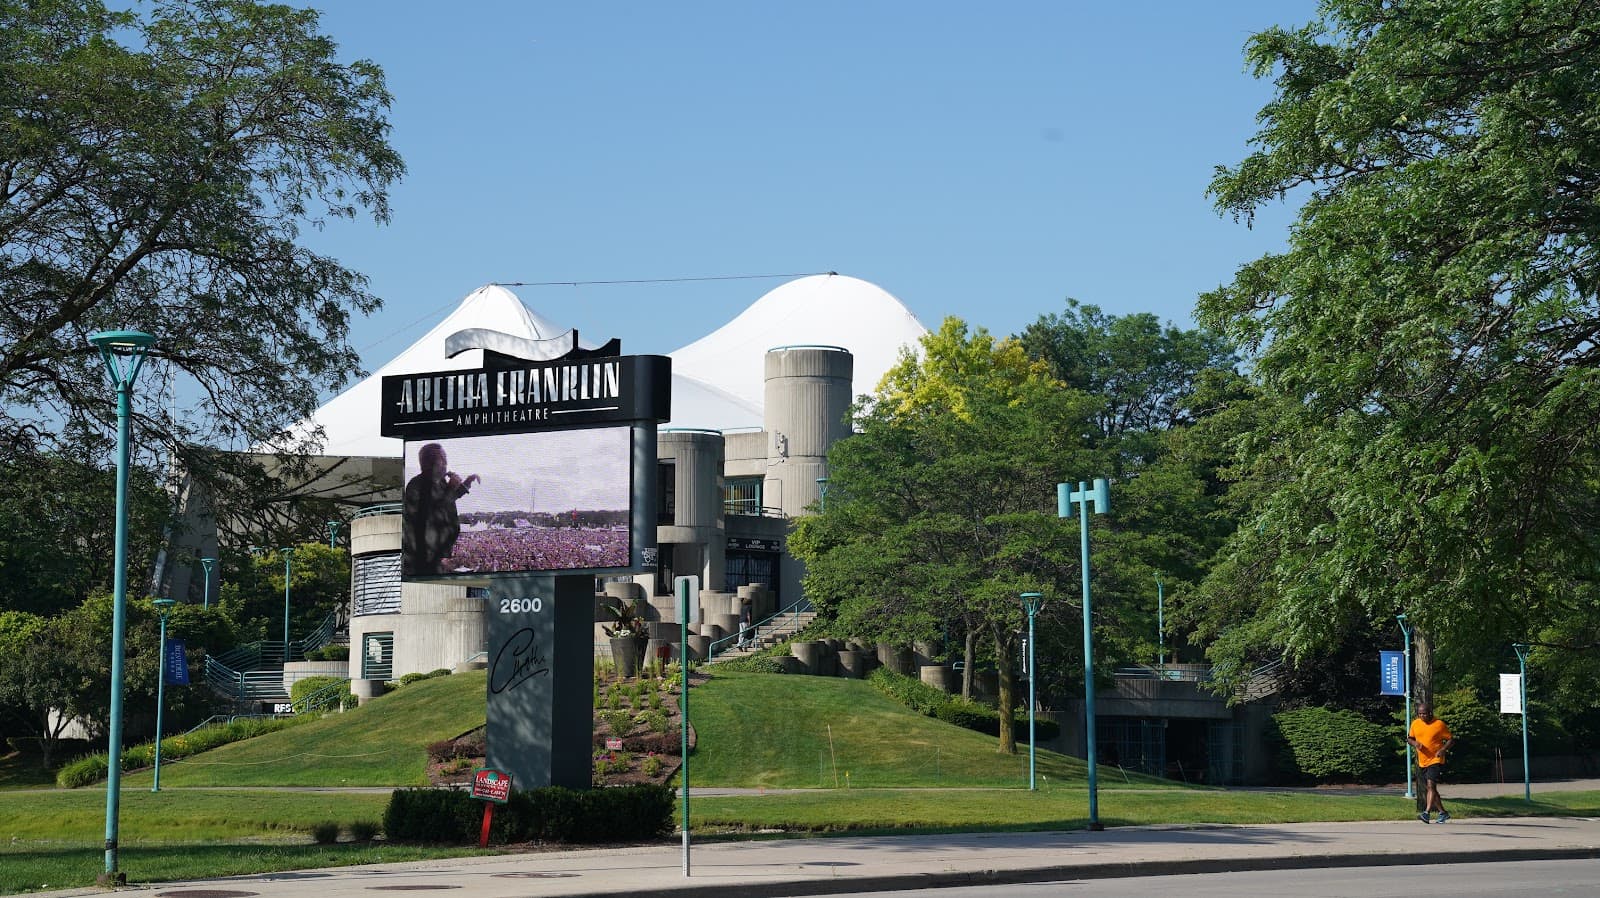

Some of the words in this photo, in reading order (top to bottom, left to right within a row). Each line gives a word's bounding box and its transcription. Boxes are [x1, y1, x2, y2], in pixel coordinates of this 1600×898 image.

[396, 373, 489, 414] ARETHA
[496, 362, 619, 406] FRANKLIN
[456, 407, 549, 426] AMPHITHEATRE
[500, 598, 542, 613] 2600
[1391, 656, 1399, 690] BELVEDERE
[475, 775, 509, 788] LANDSCAPE
